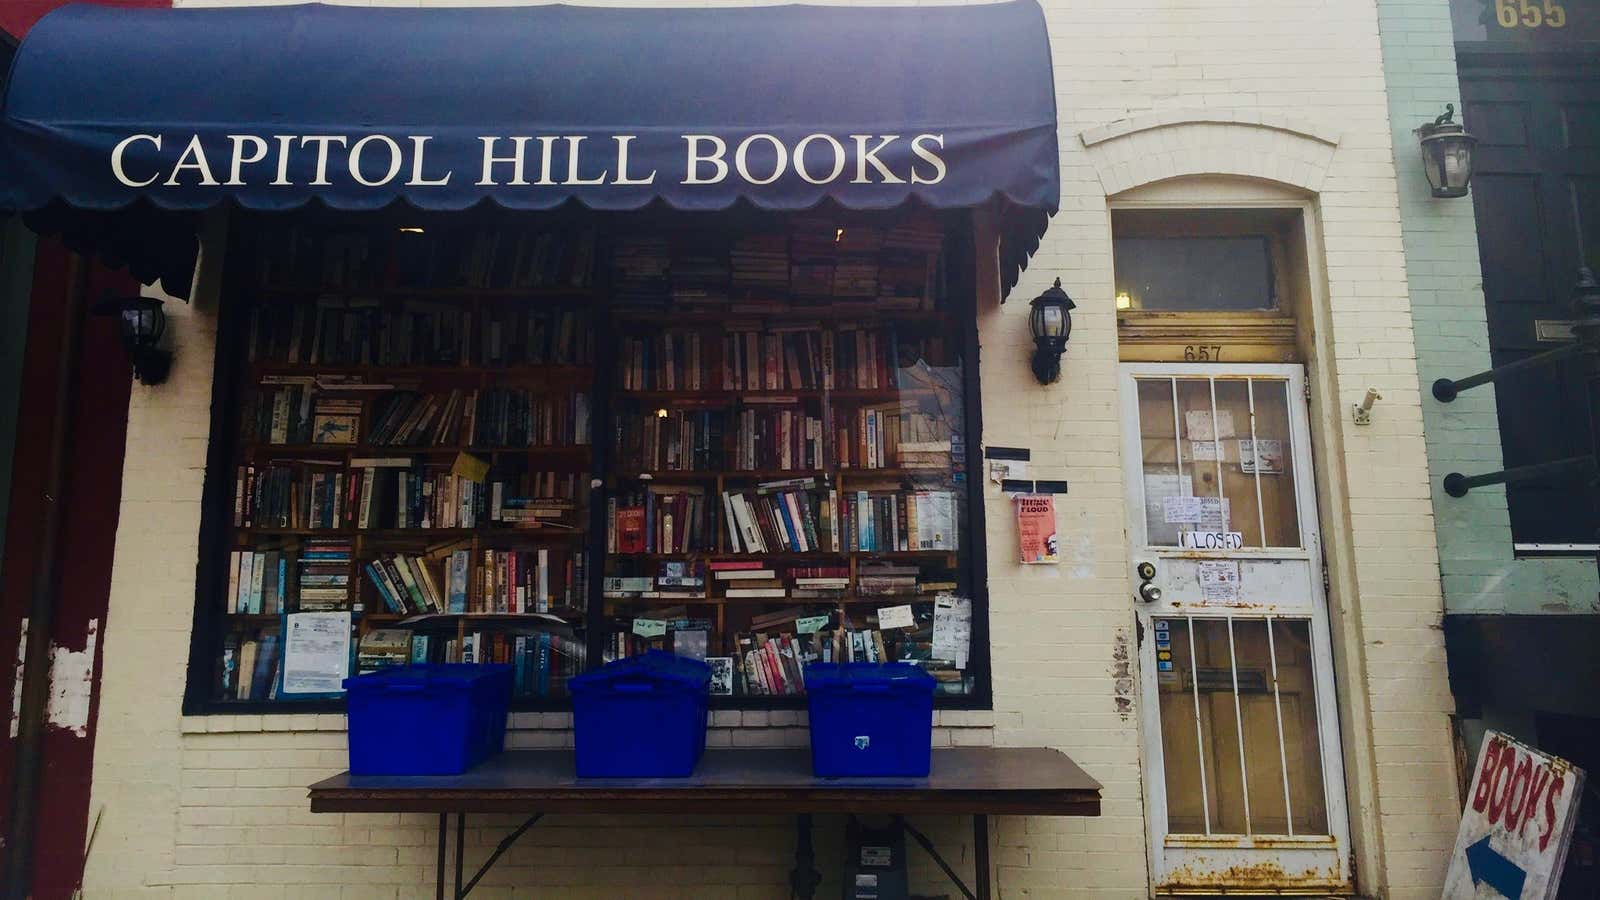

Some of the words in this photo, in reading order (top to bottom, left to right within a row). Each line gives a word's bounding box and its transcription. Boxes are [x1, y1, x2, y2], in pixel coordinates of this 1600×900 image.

[1495, 0, 1566, 28] 655
[110, 133, 452, 187] CAPITOL
[474, 134, 657, 186] HILL
[679, 133, 947, 185] BOOKS
[1184, 345, 1221, 362] 657
[1472, 736, 1565, 853] BOOKS
